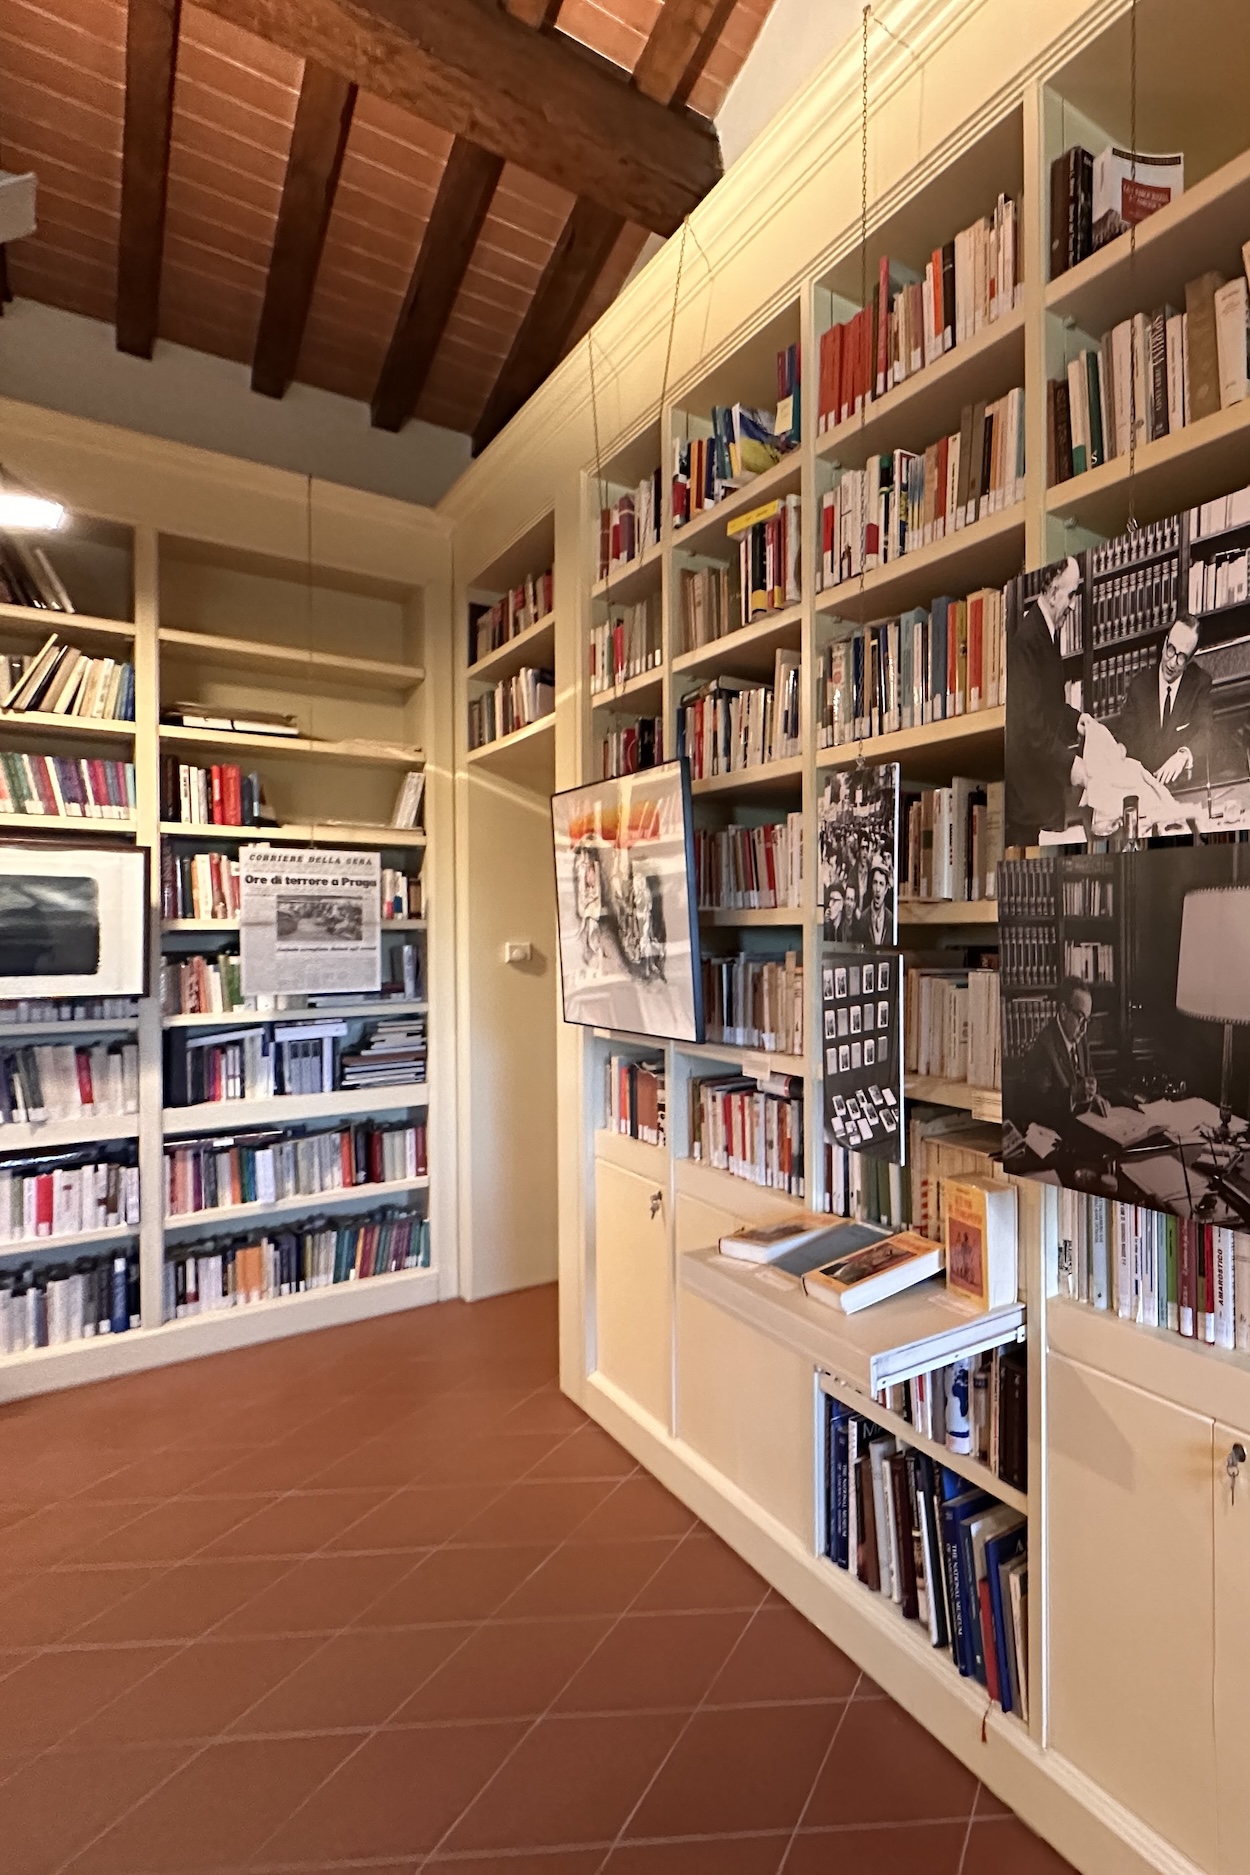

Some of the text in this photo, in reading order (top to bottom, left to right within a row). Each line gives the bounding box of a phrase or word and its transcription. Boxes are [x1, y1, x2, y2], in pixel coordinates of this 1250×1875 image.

[249, 853, 303, 862] CORRIERE
[308, 856, 340, 864] DELLA
[245, 874, 267, 884] Ore
[271, 875, 282, 885] di
[285, 876, 329, 886] terrore
[341, 877, 376, 888] Praga
[952, 1562, 961, 1598] NATIONAL
[955, 1601, 963, 1636] MUSEUM
